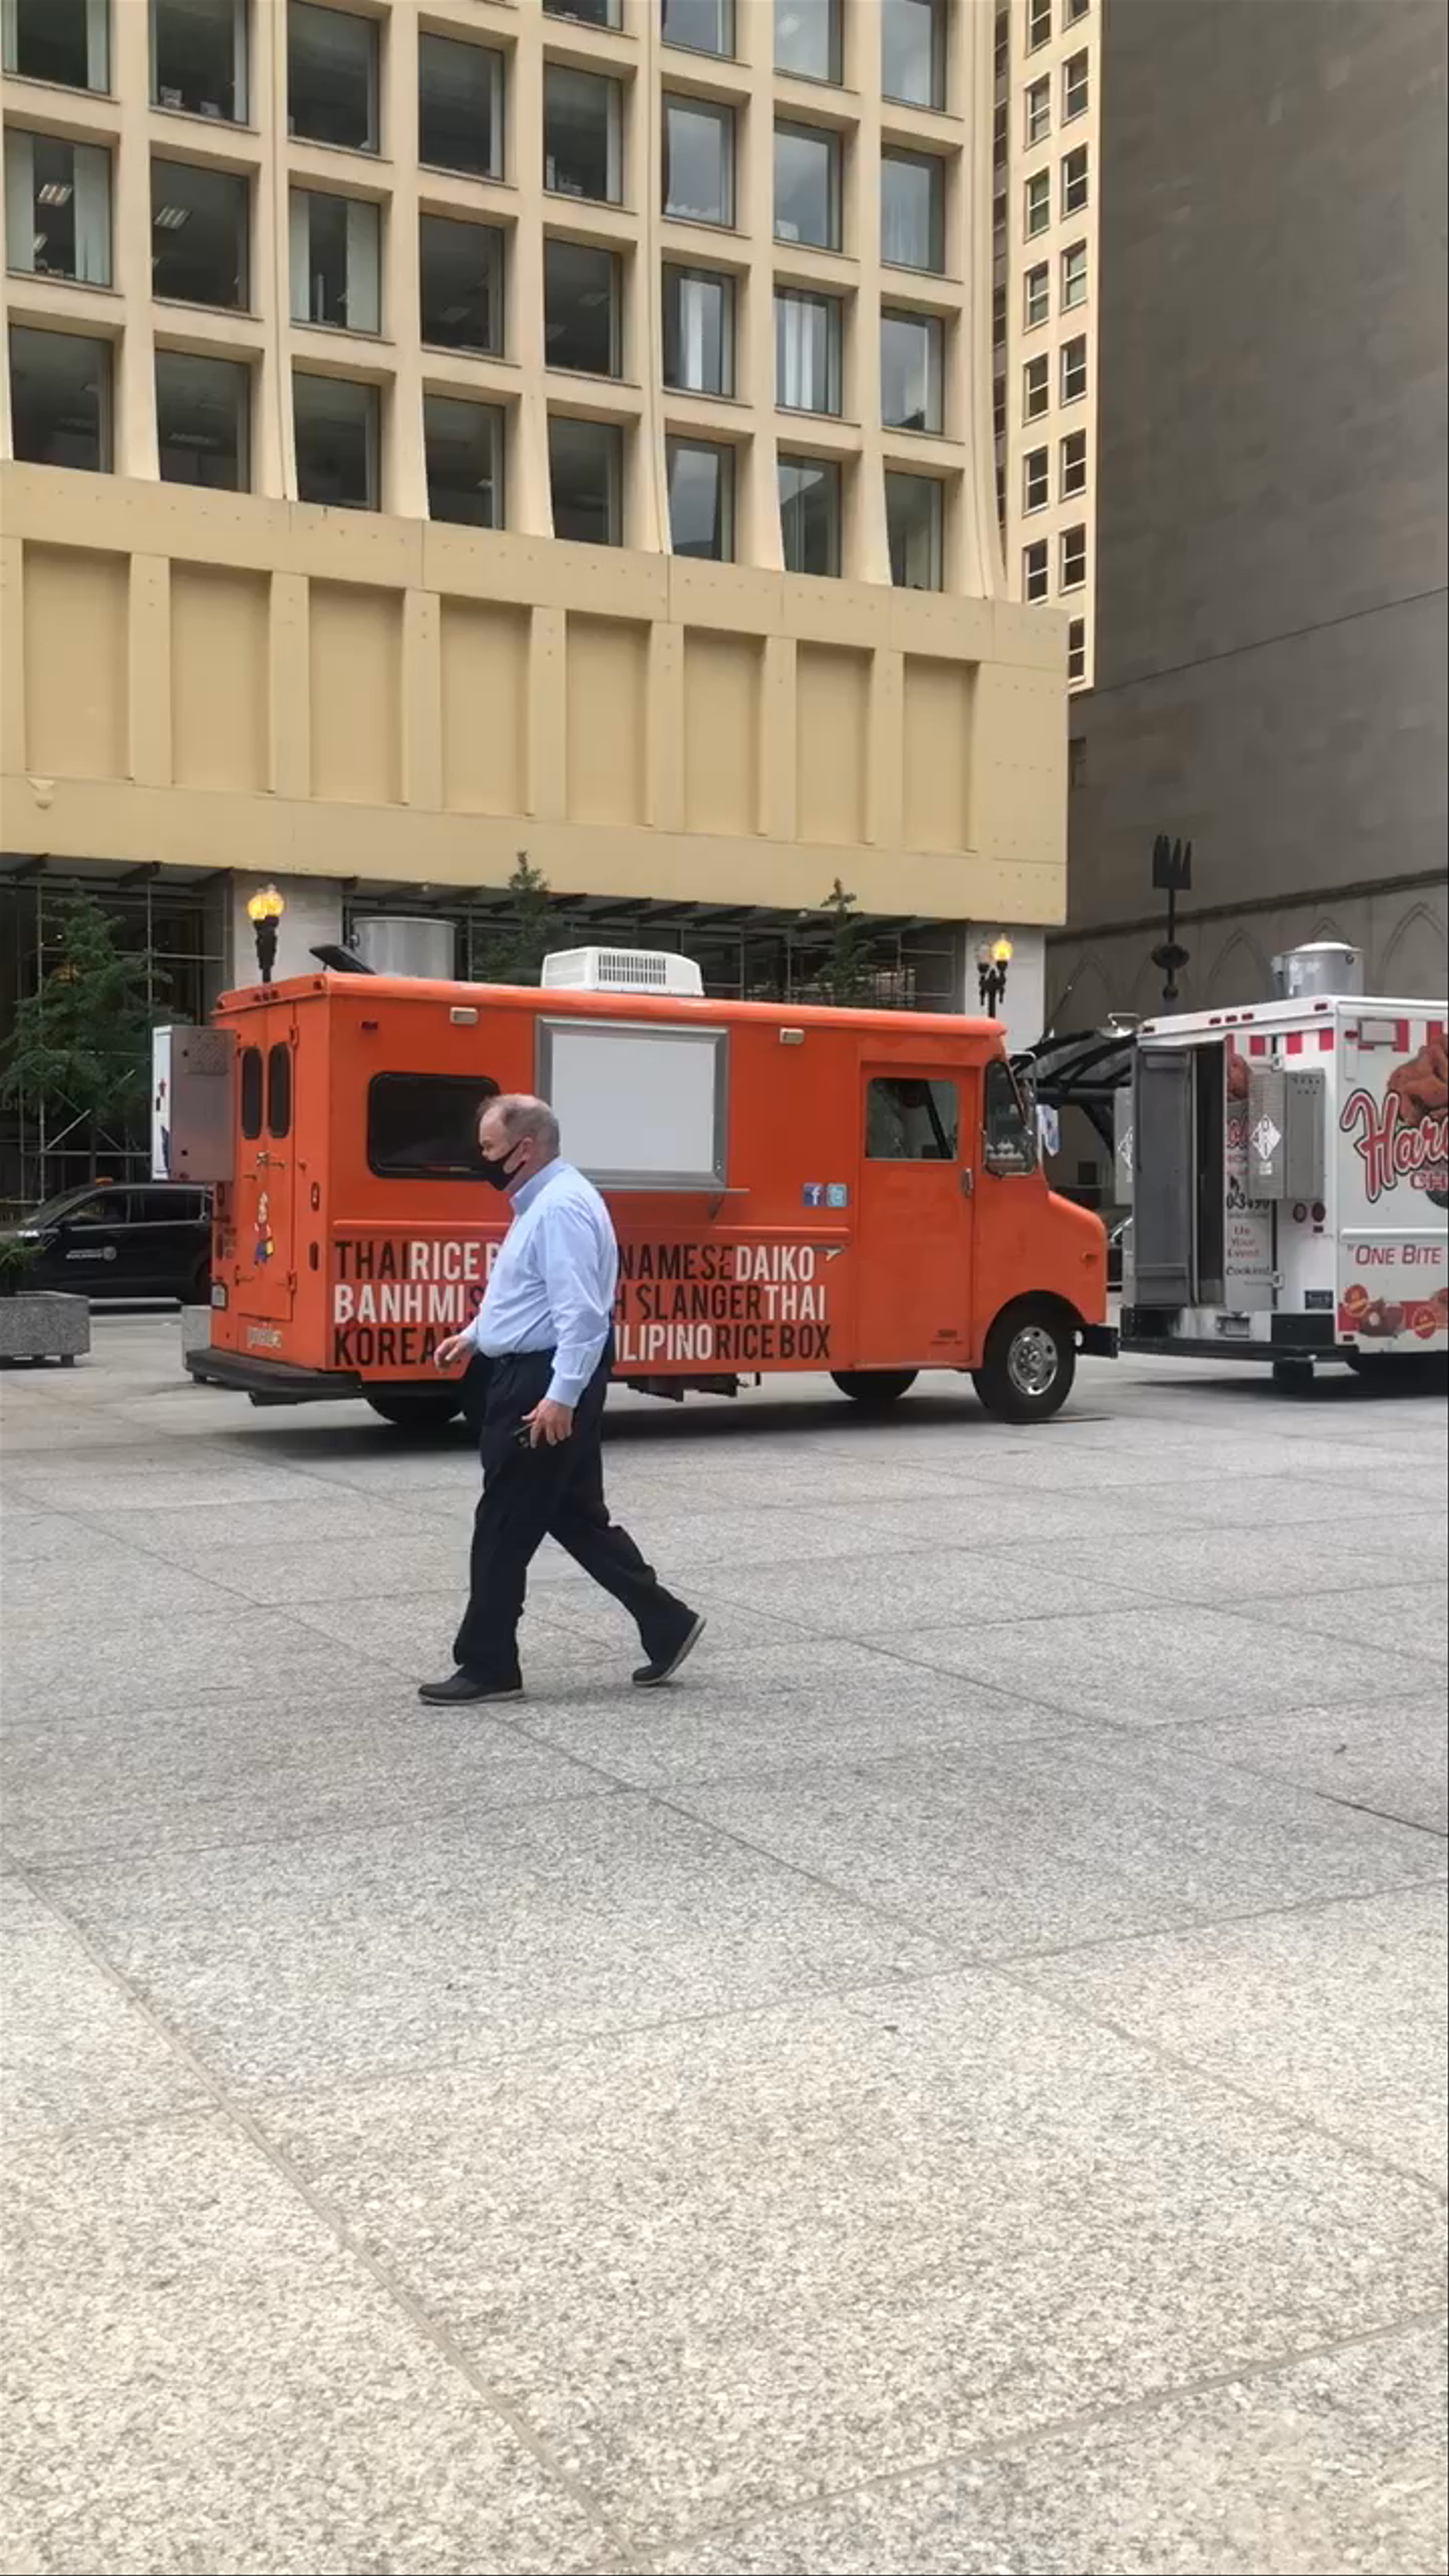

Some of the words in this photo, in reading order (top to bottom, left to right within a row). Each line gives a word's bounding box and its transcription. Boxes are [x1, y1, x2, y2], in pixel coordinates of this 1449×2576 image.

[335, 1242, 408, 1280] THAI
[411, 1242, 480, 1280] RICE
[618, 1245, 733, 1280] NAMESE
[736, 1246, 815, 1281] DAIKO
[1402, 1244, 1441, 1264] BITE
[636, 1285, 761, 1320] SLANGER
[764, 1286, 825, 1321] THAI
[615, 1324, 712, 1361] ILIPINO
[716, 1325, 775, 1359] RICE
[780, 1324, 831, 1360] BOX
